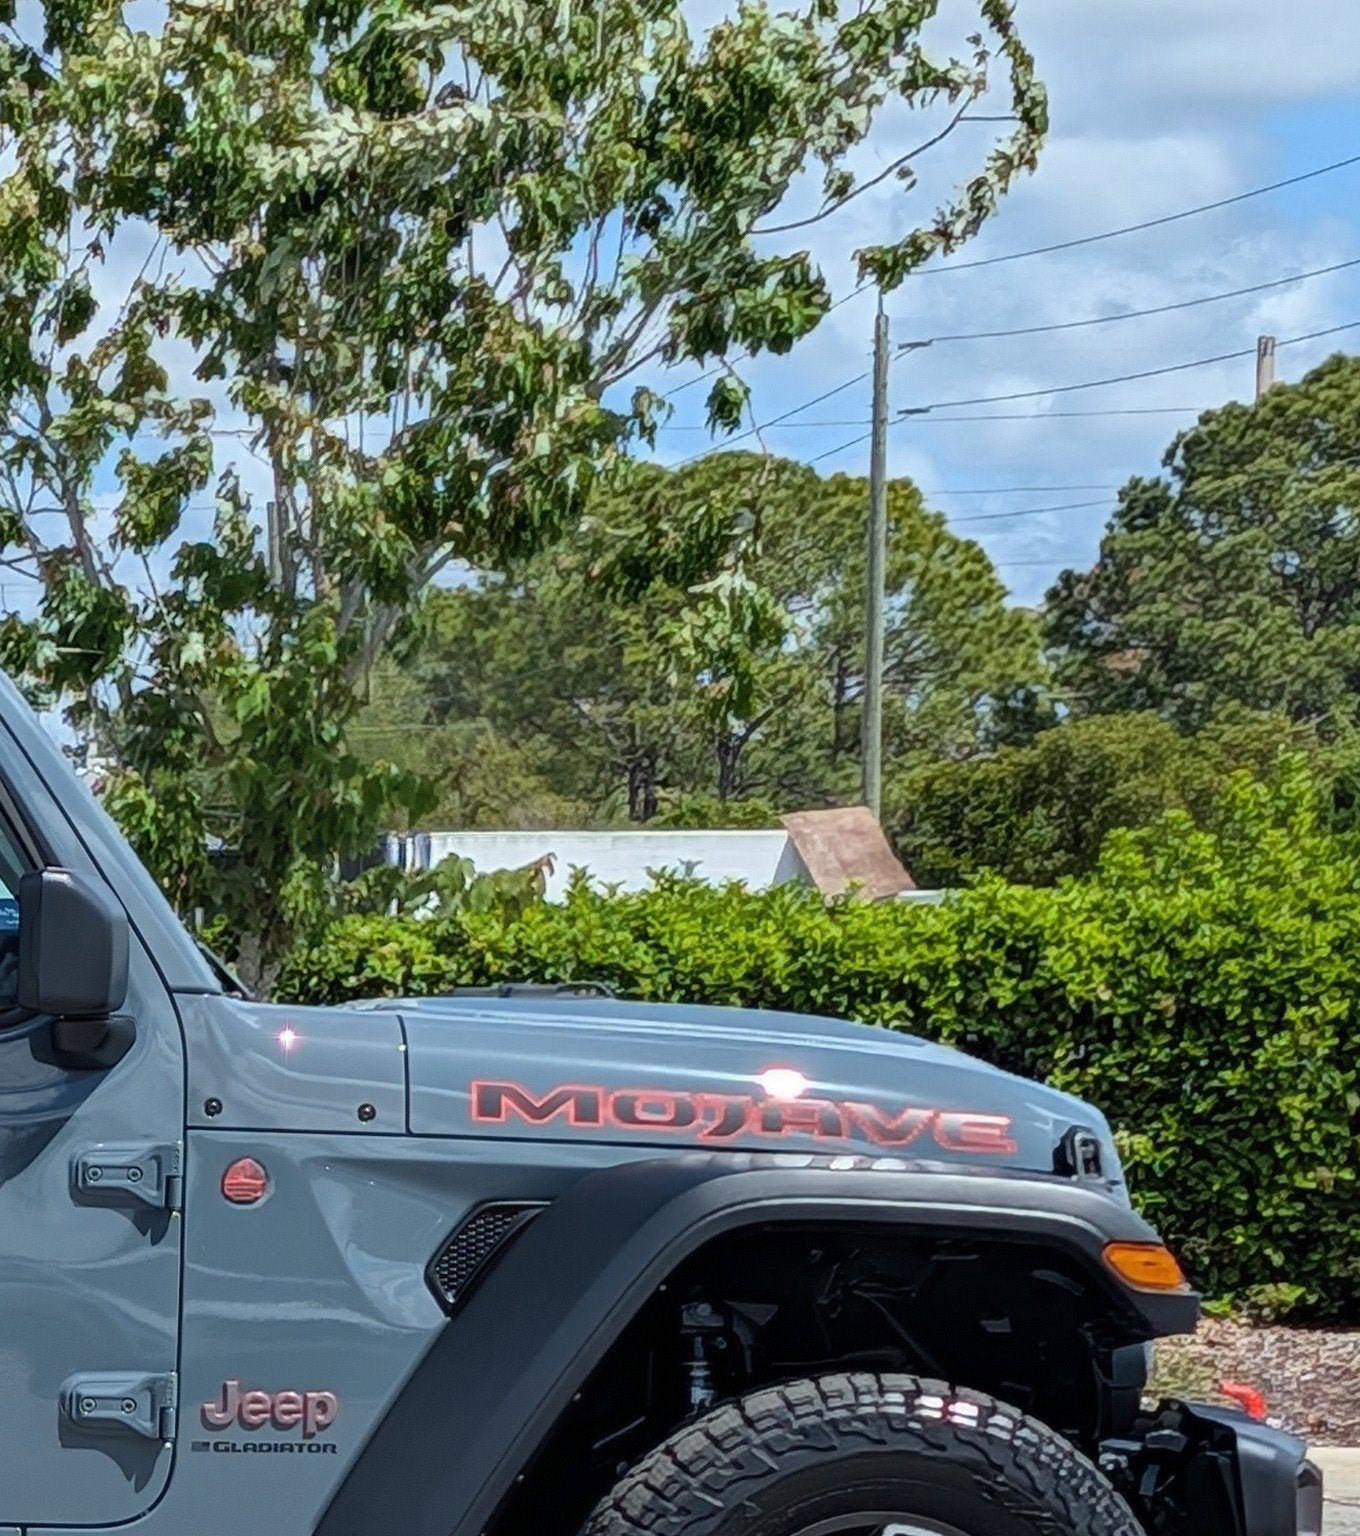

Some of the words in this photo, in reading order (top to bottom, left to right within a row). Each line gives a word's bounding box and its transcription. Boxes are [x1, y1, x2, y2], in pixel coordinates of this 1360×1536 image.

[471, 1080, 1017, 1153] MOJAVE
[200, 1378, 338, 1439] Jeep
[212, 1441, 337, 1454] GLADIATOR
